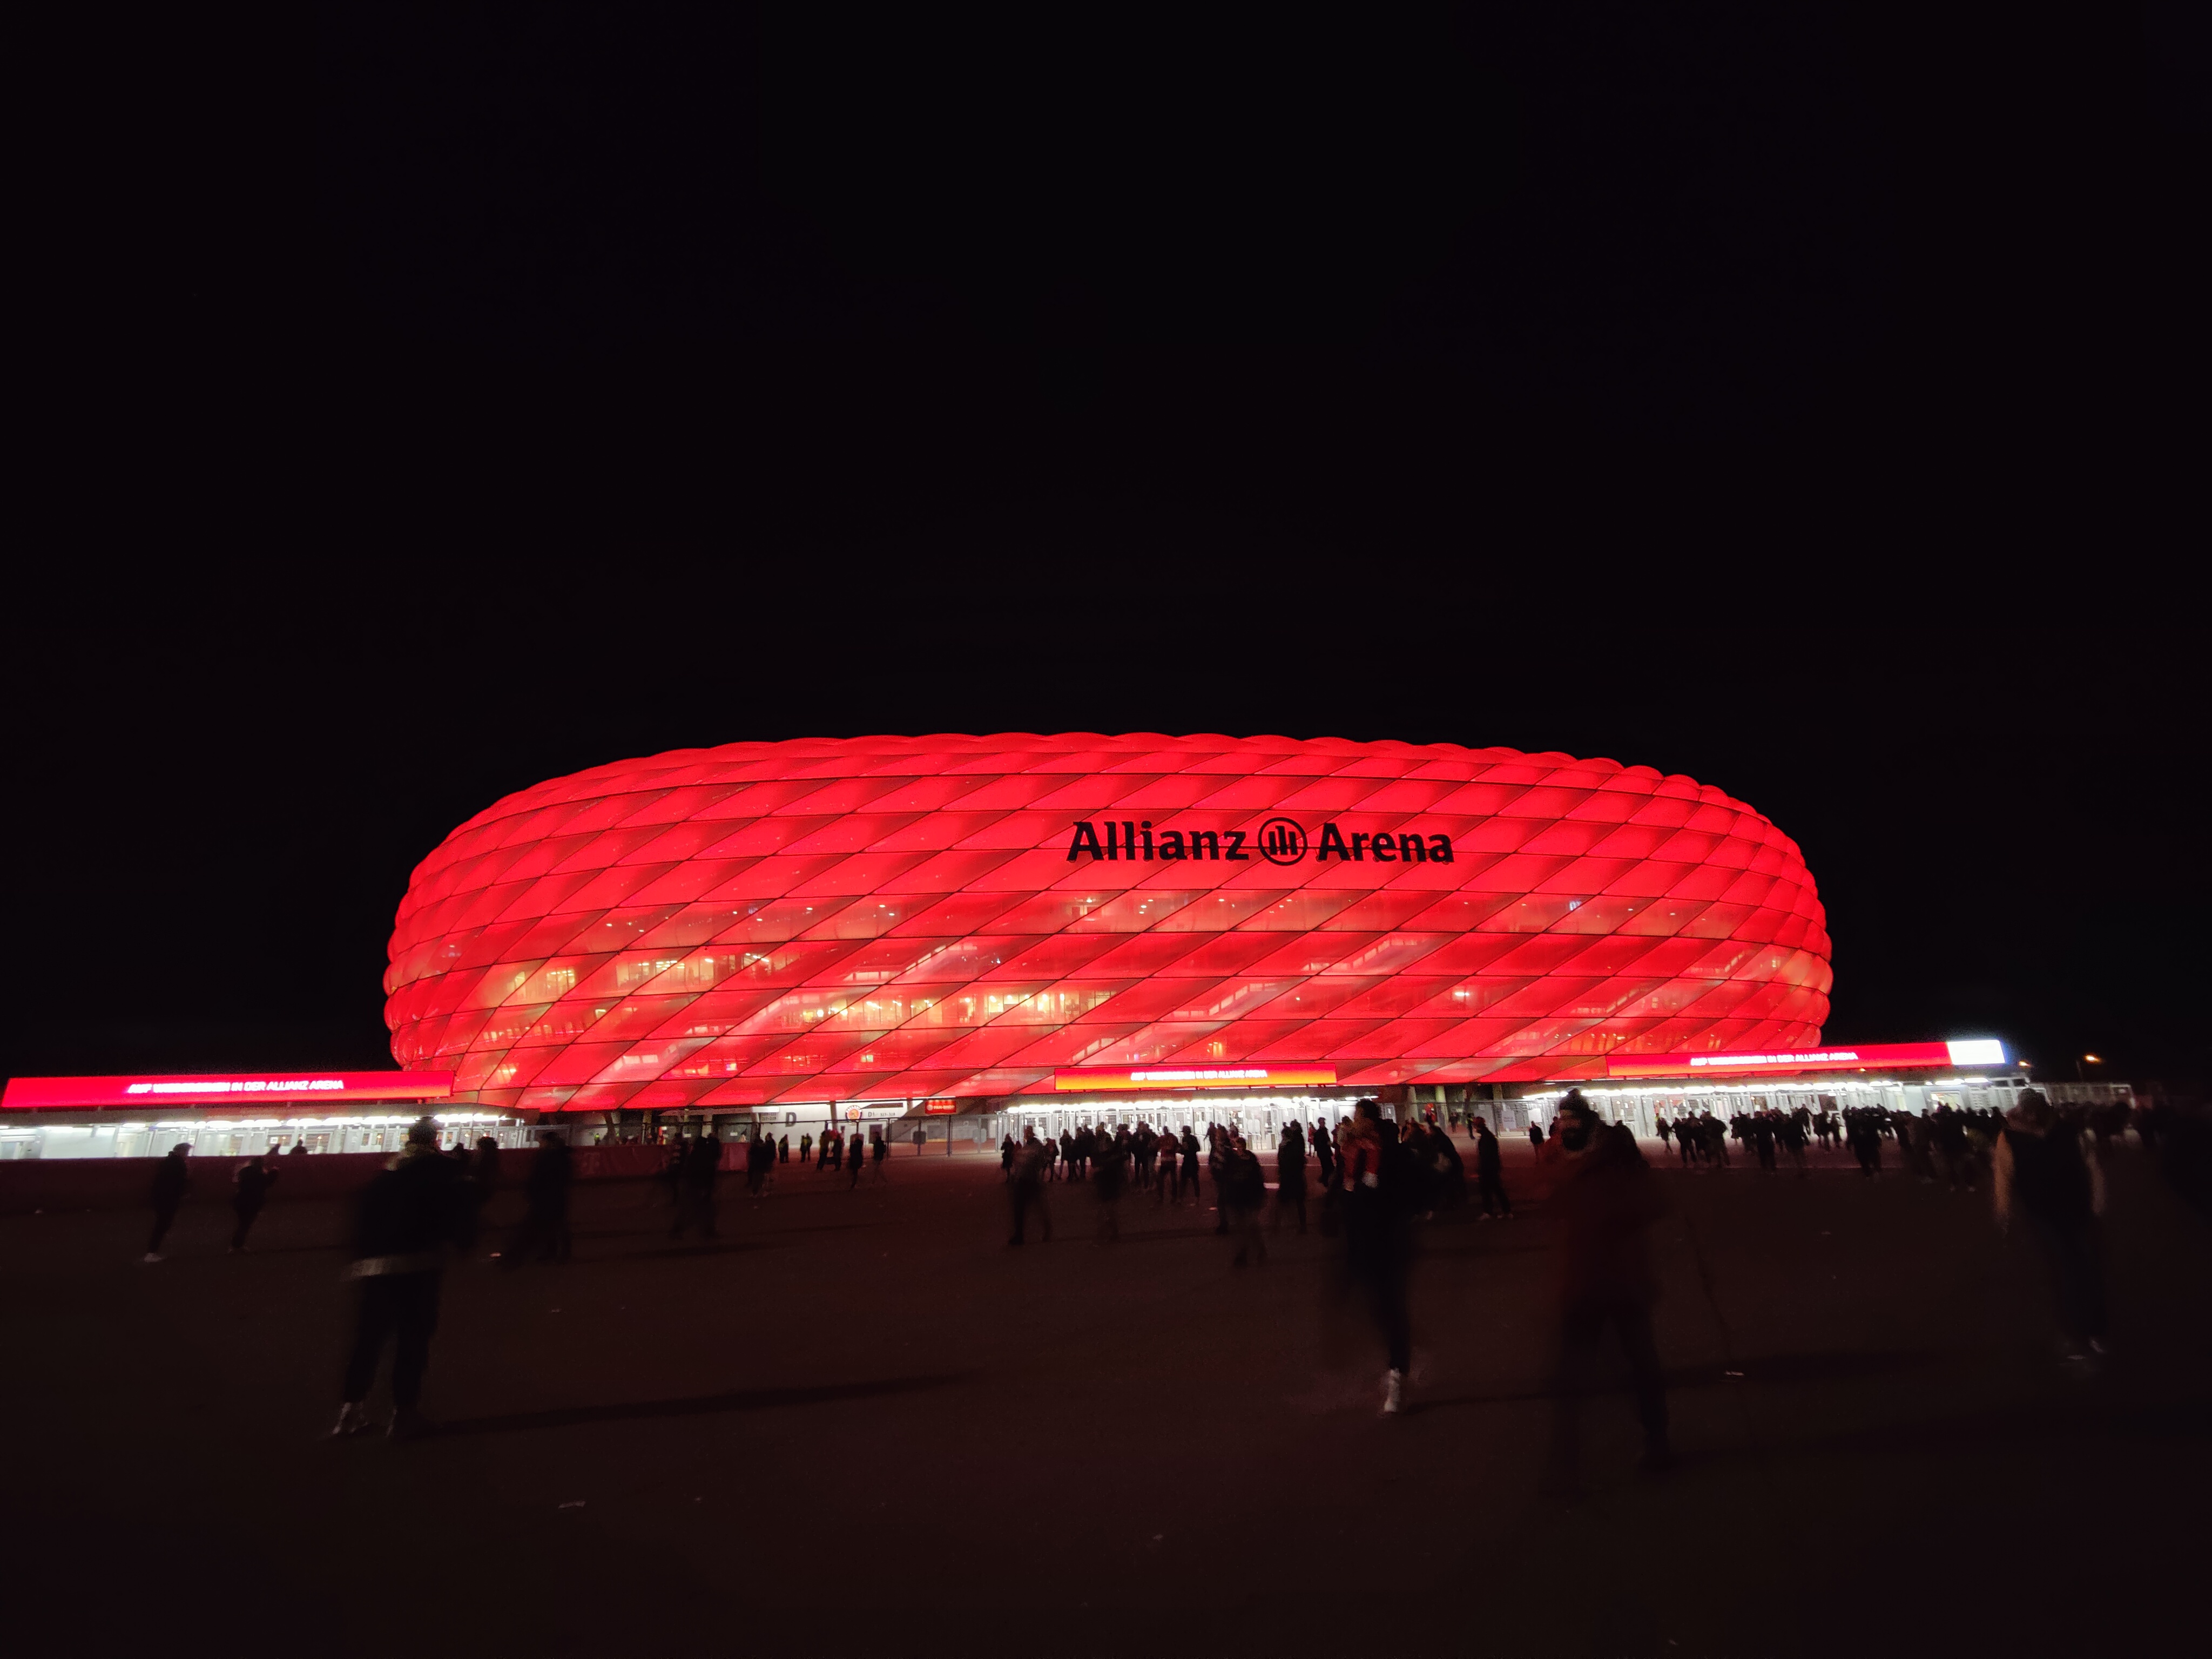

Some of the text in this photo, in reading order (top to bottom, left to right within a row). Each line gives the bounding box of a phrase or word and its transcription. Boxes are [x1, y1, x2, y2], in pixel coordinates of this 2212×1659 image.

[1066, 820, 1455, 863] Allianz Arena
[231, 1082, 242, 1091] IN
[244, 1082, 266, 1091] DER
[266, 1081, 309, 1090] ALLIANZ
[309, 1081, 343, 1090] ARENA
[786, 1112, 797, 1127] D
